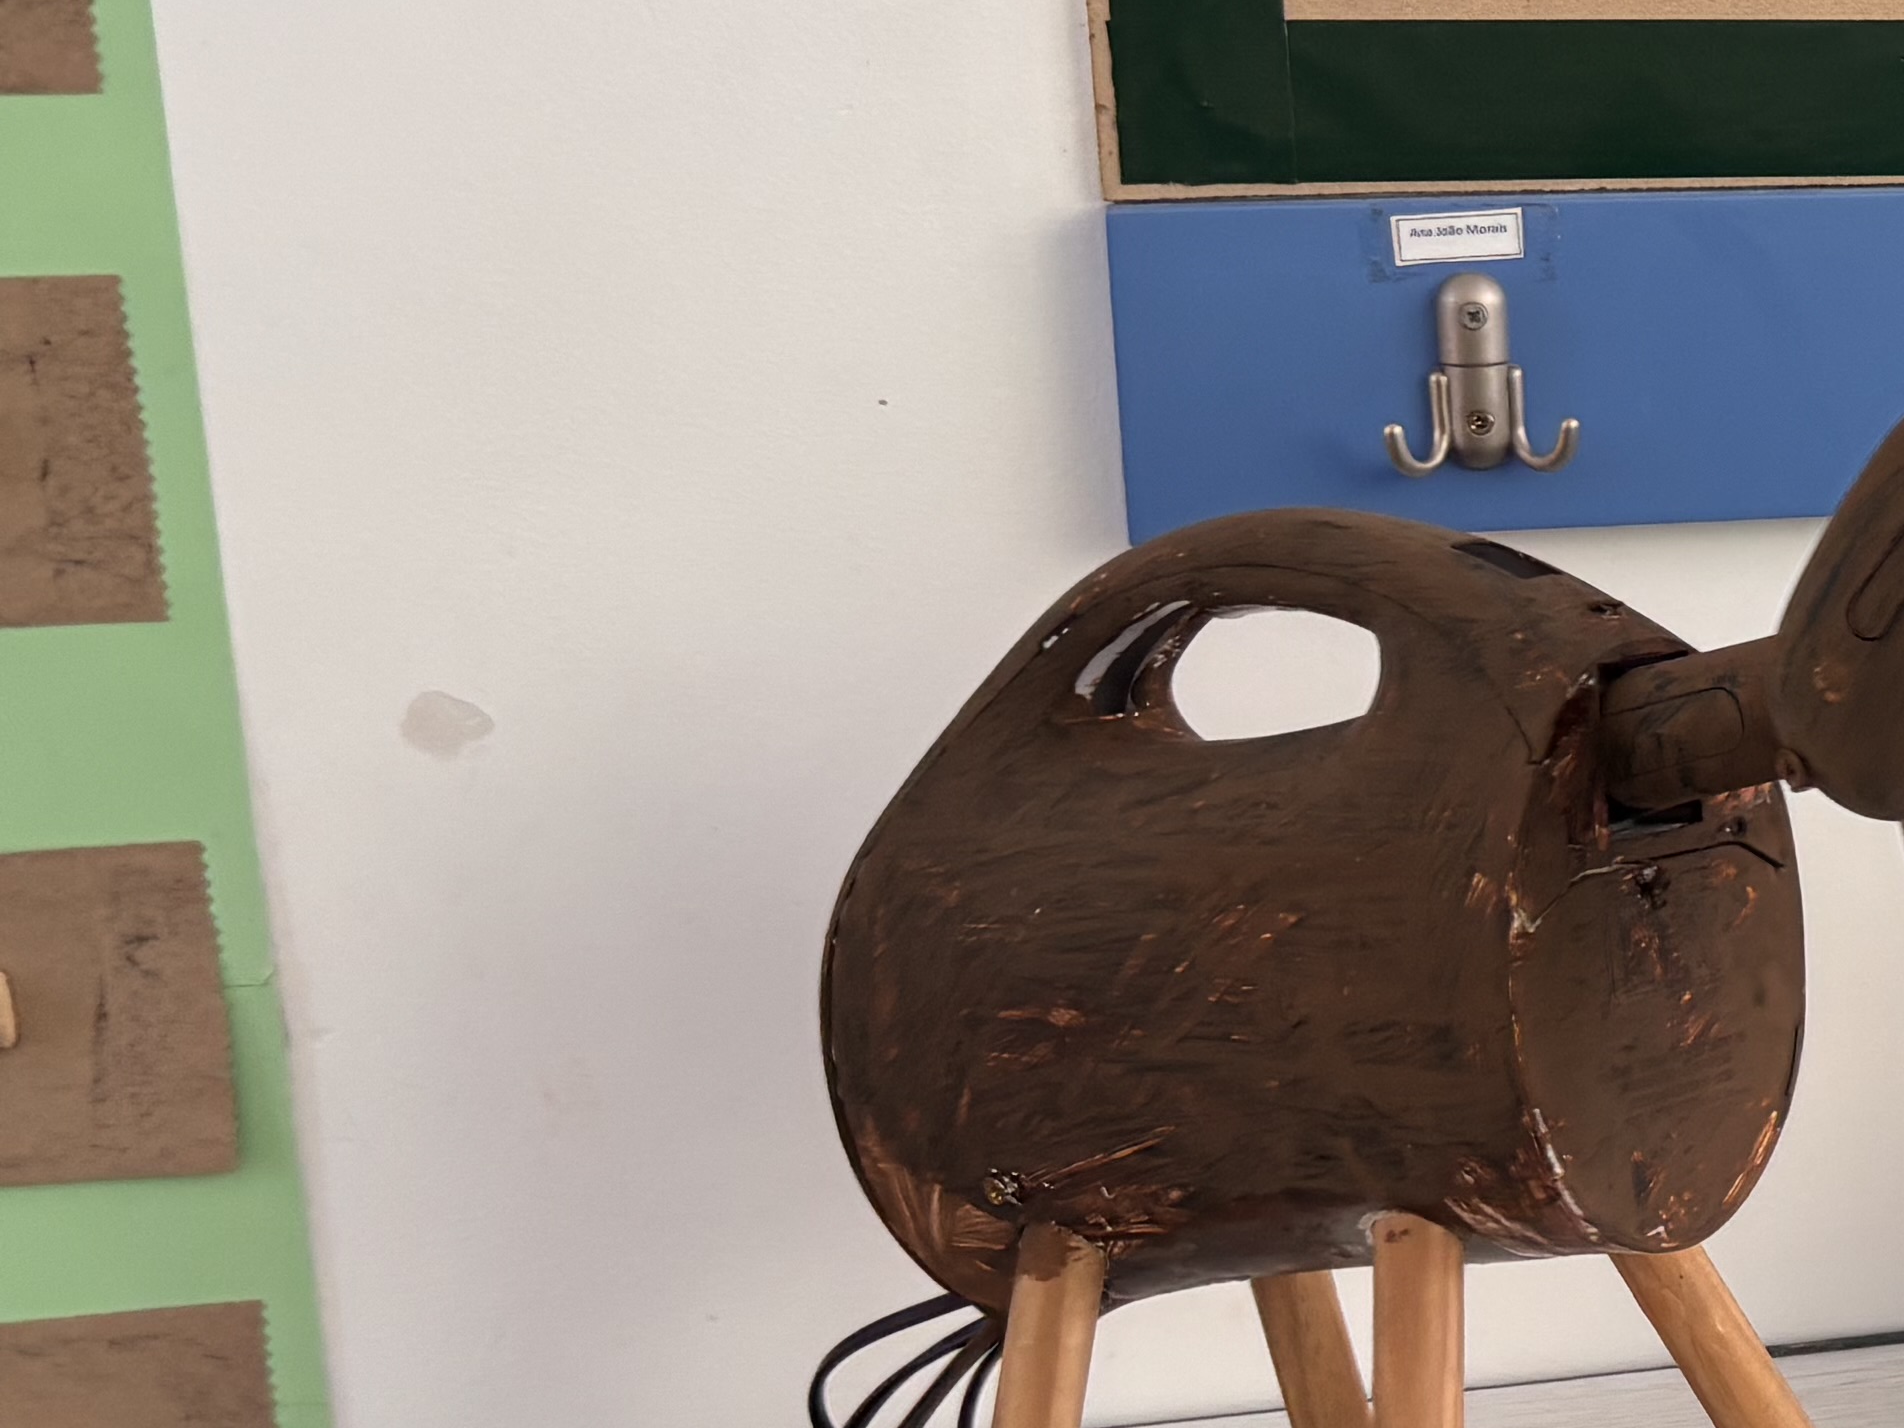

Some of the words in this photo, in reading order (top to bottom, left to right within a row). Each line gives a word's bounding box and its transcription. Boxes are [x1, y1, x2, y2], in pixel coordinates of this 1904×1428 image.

[1410, 228, 1432, 238] Ana
[1435, 225, 1462, 237] João
[1466, 223, 1507, 235] Morais
